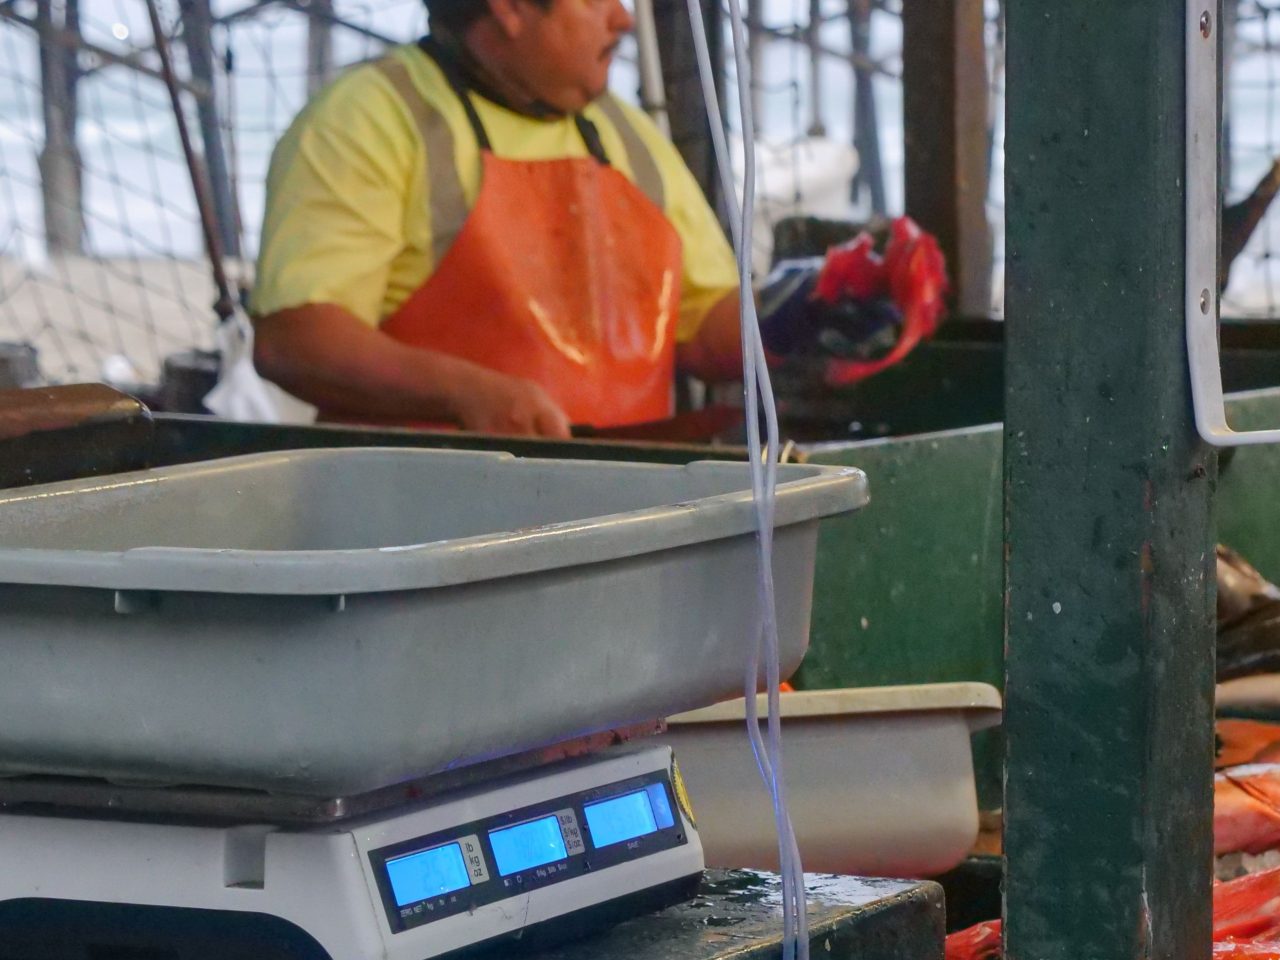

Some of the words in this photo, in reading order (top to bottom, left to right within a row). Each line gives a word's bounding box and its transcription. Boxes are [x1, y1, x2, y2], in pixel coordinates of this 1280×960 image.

[465, 843, 474, 853] lb
[469, 856, 480, 867] kg
[473, 868, 483, 877] oz
